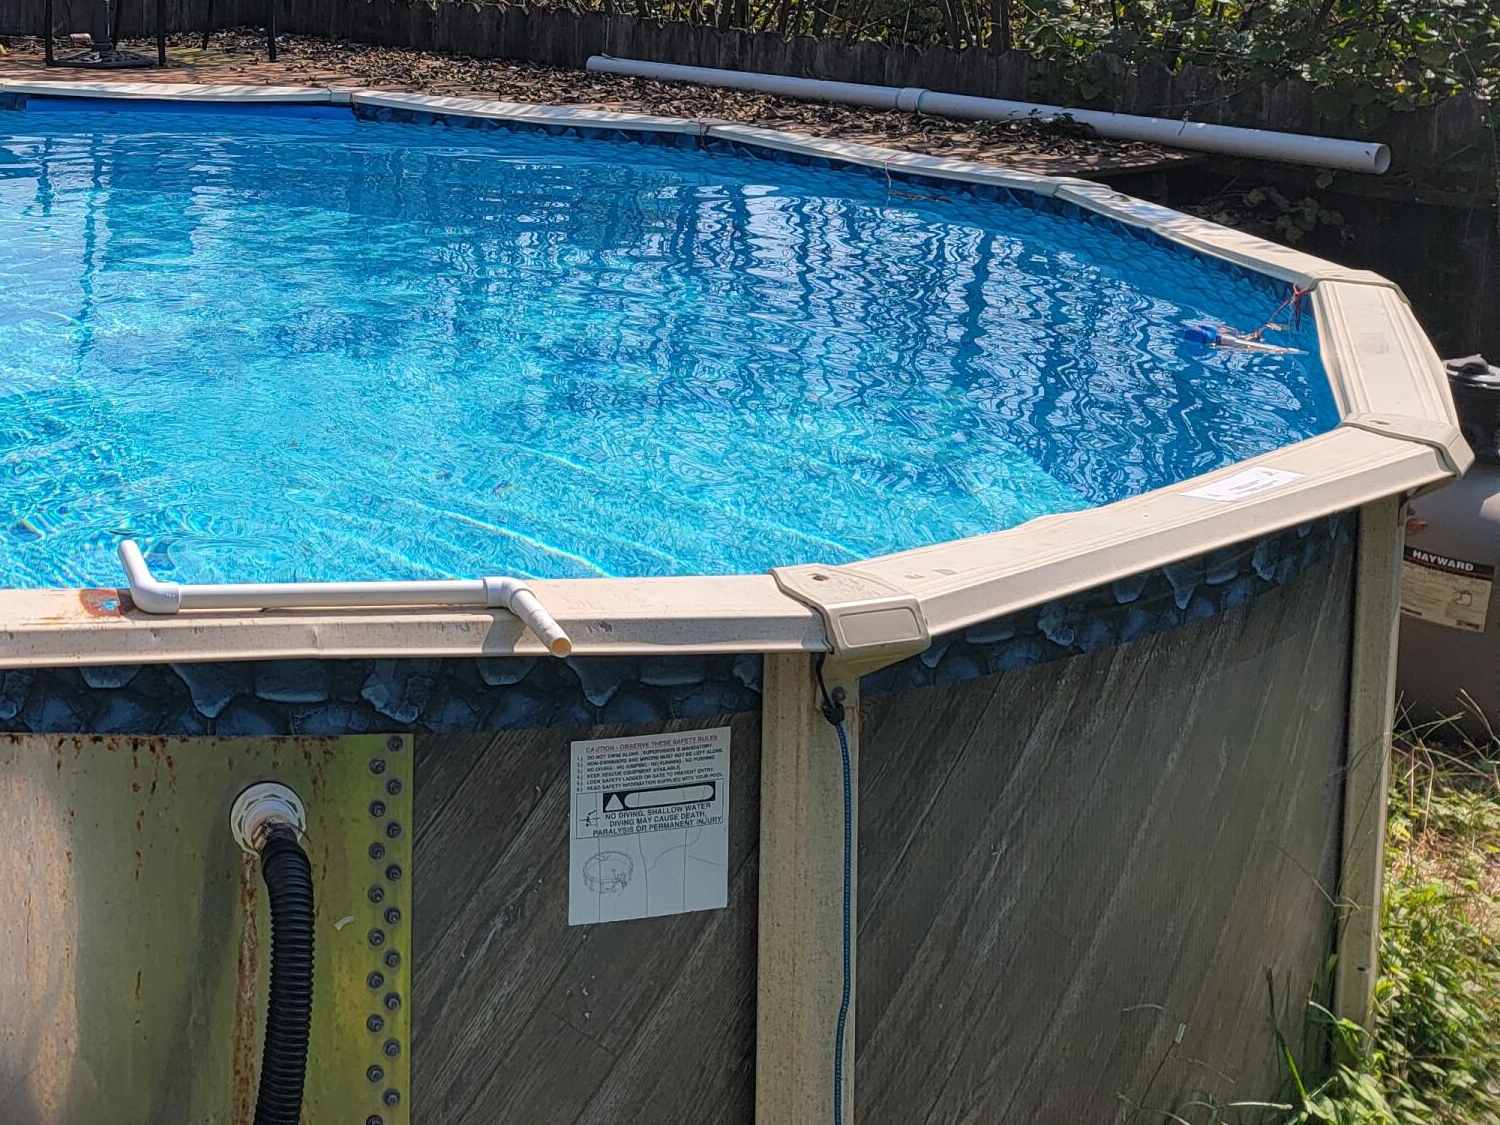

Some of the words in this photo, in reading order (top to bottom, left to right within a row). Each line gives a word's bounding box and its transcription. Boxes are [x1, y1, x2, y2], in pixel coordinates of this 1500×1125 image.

[1412, 549, 1475, 572] HAYWARD
[586, 745, 615, 753] CAUTION
[620, 742, 648, 750] OBSERVE
[651, 739, 672, 747] THESE
[673, 736, 697, 745] SAFETY
[698, 734, 717, 743] RULES
[643, 747, 676, 755] SUPERVISION
[623, 768, 651, 776] EQUIPMENT
[622, 780, 656, 788] INFORMATION
[605, 812, 617, 820] NO
[647, 806, 684, 816] SHALLOW
[684, 802, 711, 812] WATER
[592, 826, 634, 836] PARALYSIS
[649, 820, 694, 831] PERMANENT
[610, 818, 635, 828] DIVING
[636, 816, 653, 825] MAY
[654, 814, 679, 822] CAUSE
